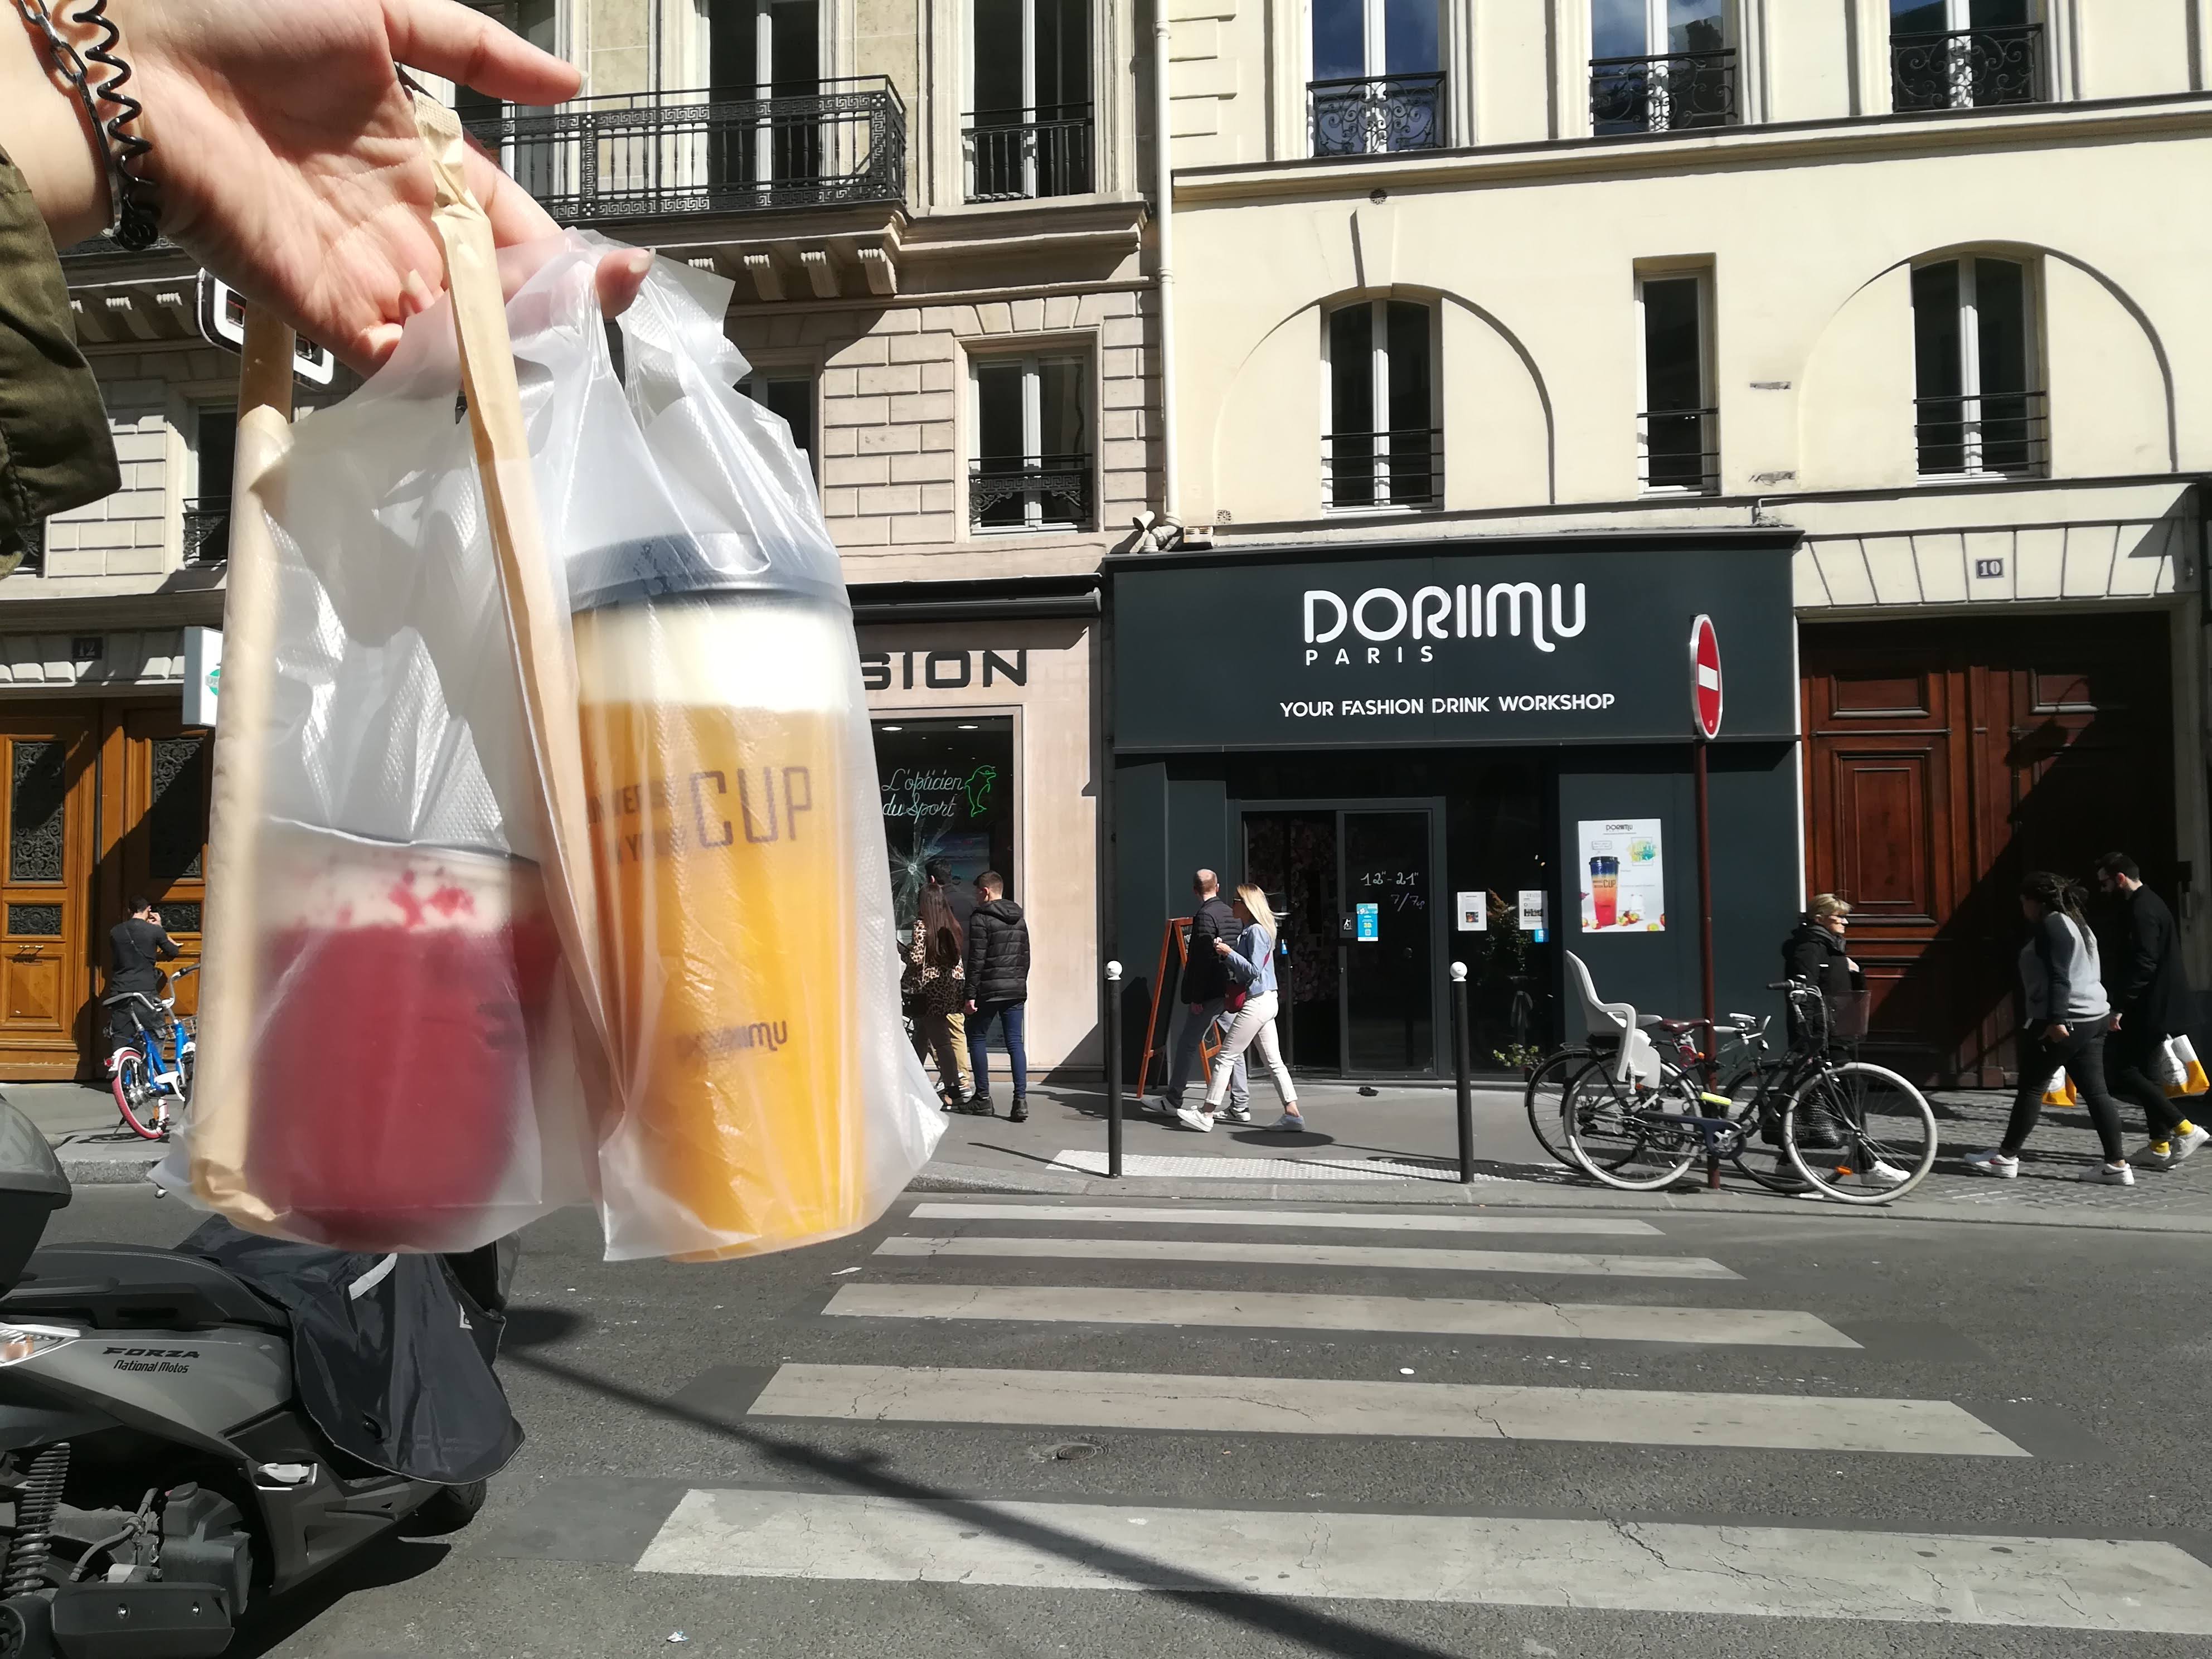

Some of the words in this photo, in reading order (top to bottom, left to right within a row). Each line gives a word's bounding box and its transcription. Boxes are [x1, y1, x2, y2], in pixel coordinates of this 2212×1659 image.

[1980, 561, 2000, 575] 10
[1304, 582, 1586, 652] DORIIMU
[79, 642, 95, 657] 12
[1305, 645, 1433, 666] PARIS
[1280, 701, 1334, 717] YOUR
[1341, 698, 1424, 716] FASHION
[1432, 696, 1490, 714] DRINK
[1498, 693, 1615, 712] WORKSHOP
[881, 768, 964, 798] L'opticien
[689, 766, 813, 848] CUP
[882, 793, 904, 816] du
[906, 792, 958, 824] Sport
[103, 1347, 200, 1359] FORZA
[113, 1360, 159, 1372] National
[158, 1362, 190, 1374] Motos
